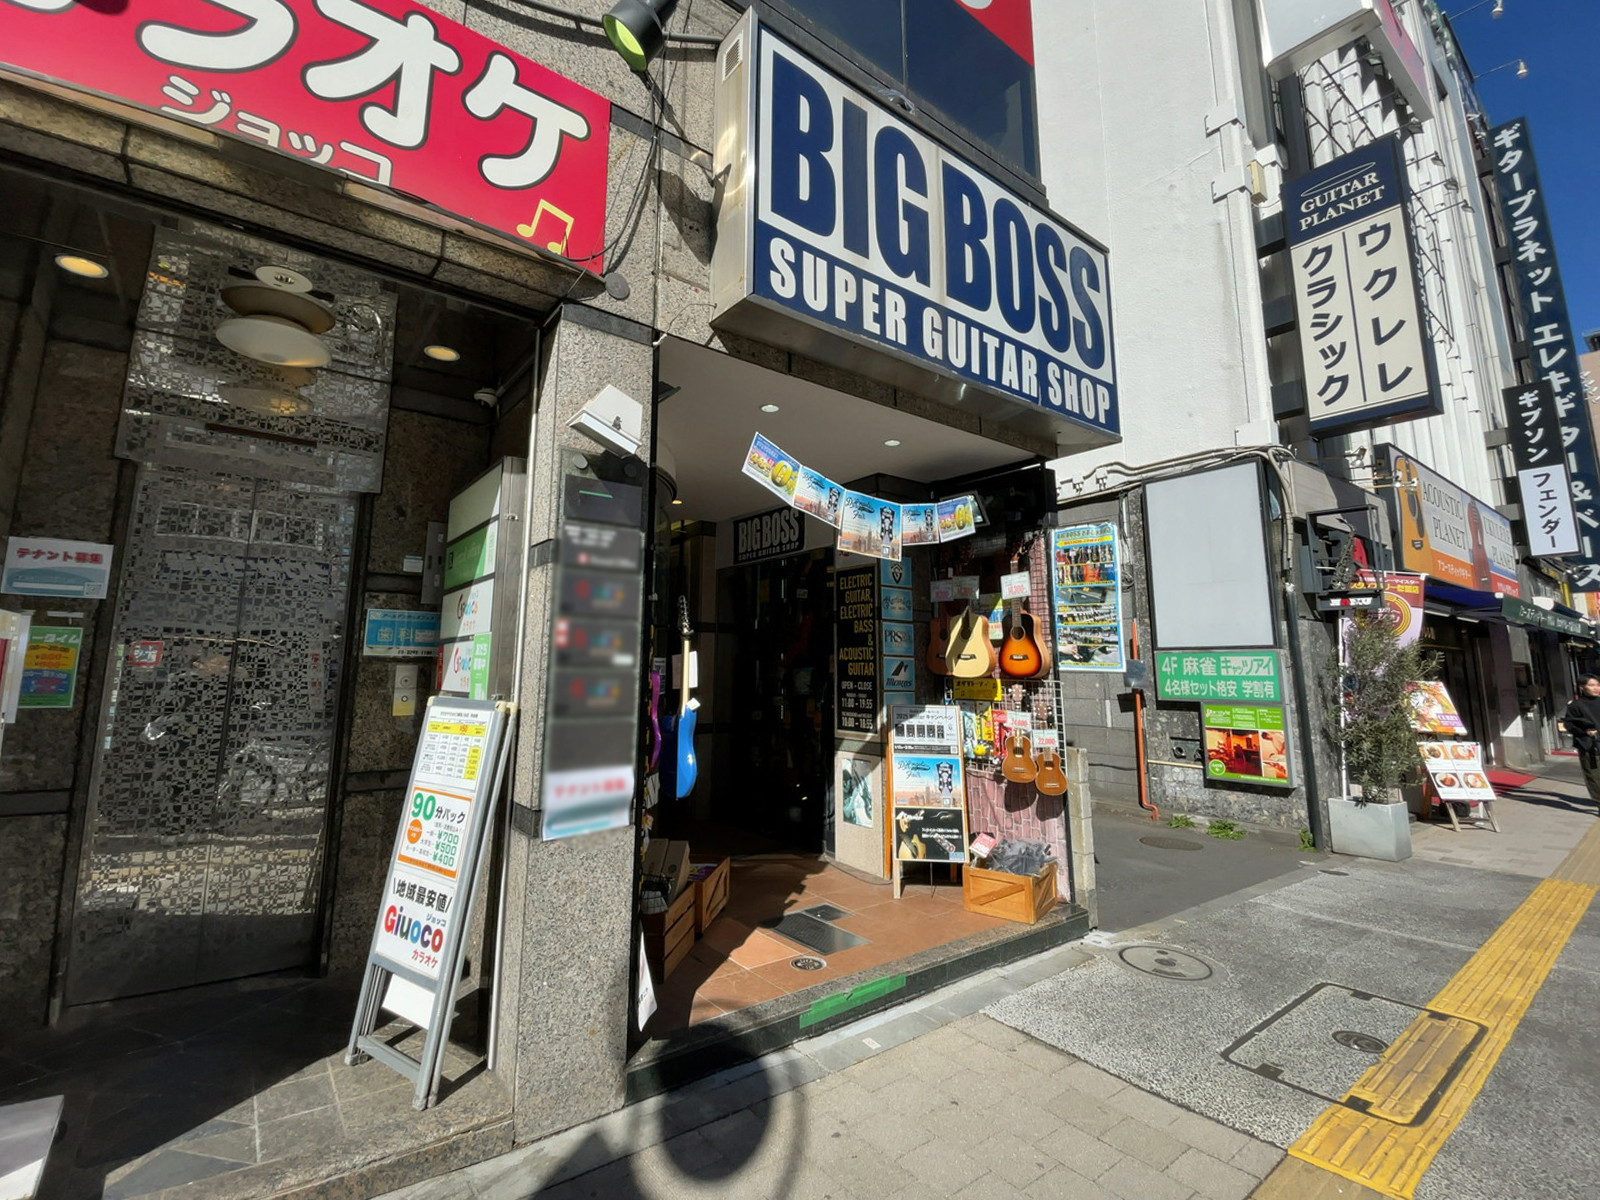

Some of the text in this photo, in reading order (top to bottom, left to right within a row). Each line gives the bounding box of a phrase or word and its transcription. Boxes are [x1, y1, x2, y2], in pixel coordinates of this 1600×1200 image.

[1300, 171, 1380, 213] GUITAR
[1299, 185, 1385, 232] PLANET
[1494, 123, 1552, 314] ギタープラネット
[1358, 222, 1413, 393] ウクレレ
[769, 237, 1111, 425] SUPER GUITAR SHOP
[1302, 244, 1350, 407] クラシック
[1518, 390, 1549, 463] ギブソン
[1422, 481, 1463, 521] ACOUSTIC
[1432, 516, 1466, 550] PLANET
[840, 573, 873, 590] ELECTRIC
[840, 603, 873, 619] ELECTRIC
[854, 620, 874, 634] BASS
[867, 634, 874, 645] &
[839, 647, 874, 661] ACOUSTIC
[847, 662, 875, 676] GUITAR
[1161, 656, 1178, 675] 4F
[1182, 656, 1217, 676] 麻雀
[841, 681, 854, 690] OPEN
[857, 682, 873, 691] CLOSE
[1164, 679, 1275, 699] 4名様セット格安 学割有
[411, 792, 437, 821] 90
[437, 829, 460, 845] ¥700
[435, 840, 458, 856] ¥500
[432, 851, 455, 867] ¥400
[384, 904, 444, 953] Giuoco
[411, 948, 438, 969] カラオケ
